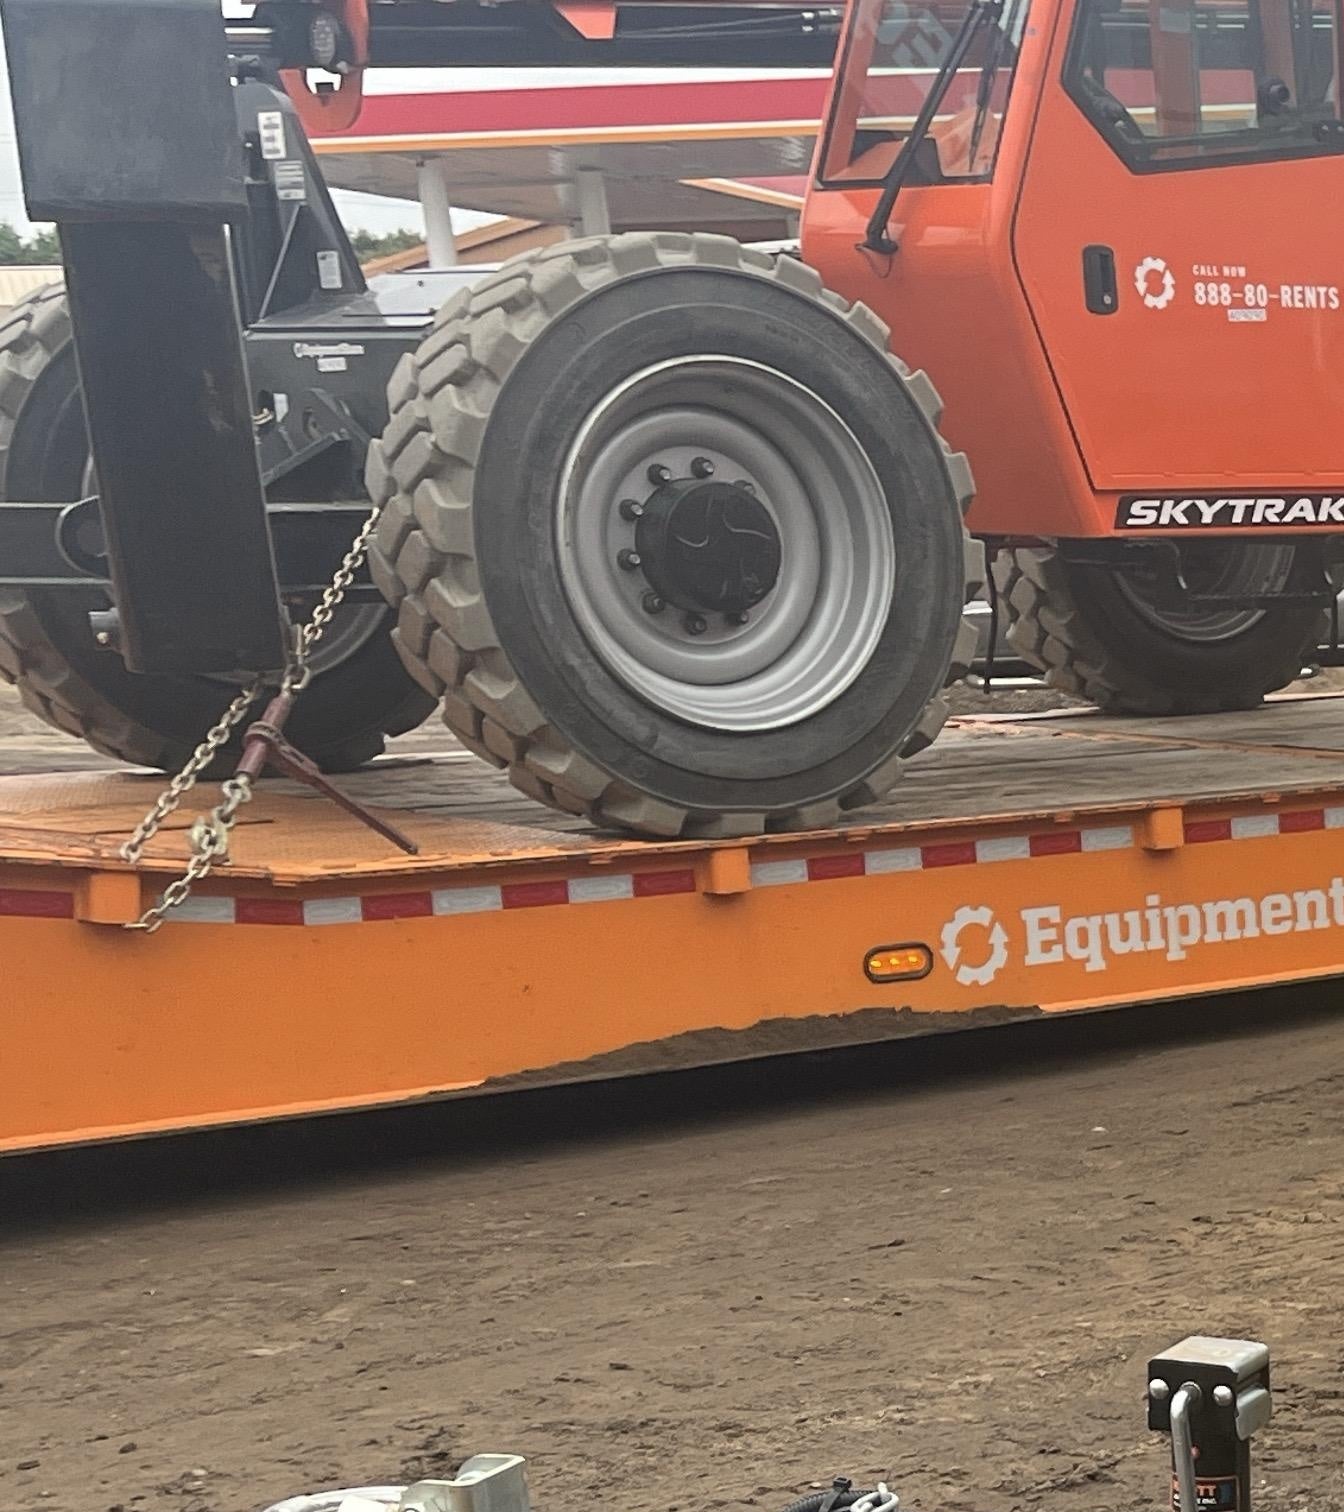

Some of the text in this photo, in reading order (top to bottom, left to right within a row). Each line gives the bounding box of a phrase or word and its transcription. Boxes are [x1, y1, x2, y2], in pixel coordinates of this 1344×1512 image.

[1192, 264, 1246, 277] CALL NOW
[1194, 282, 1340, 309] 888-80-RENTS
